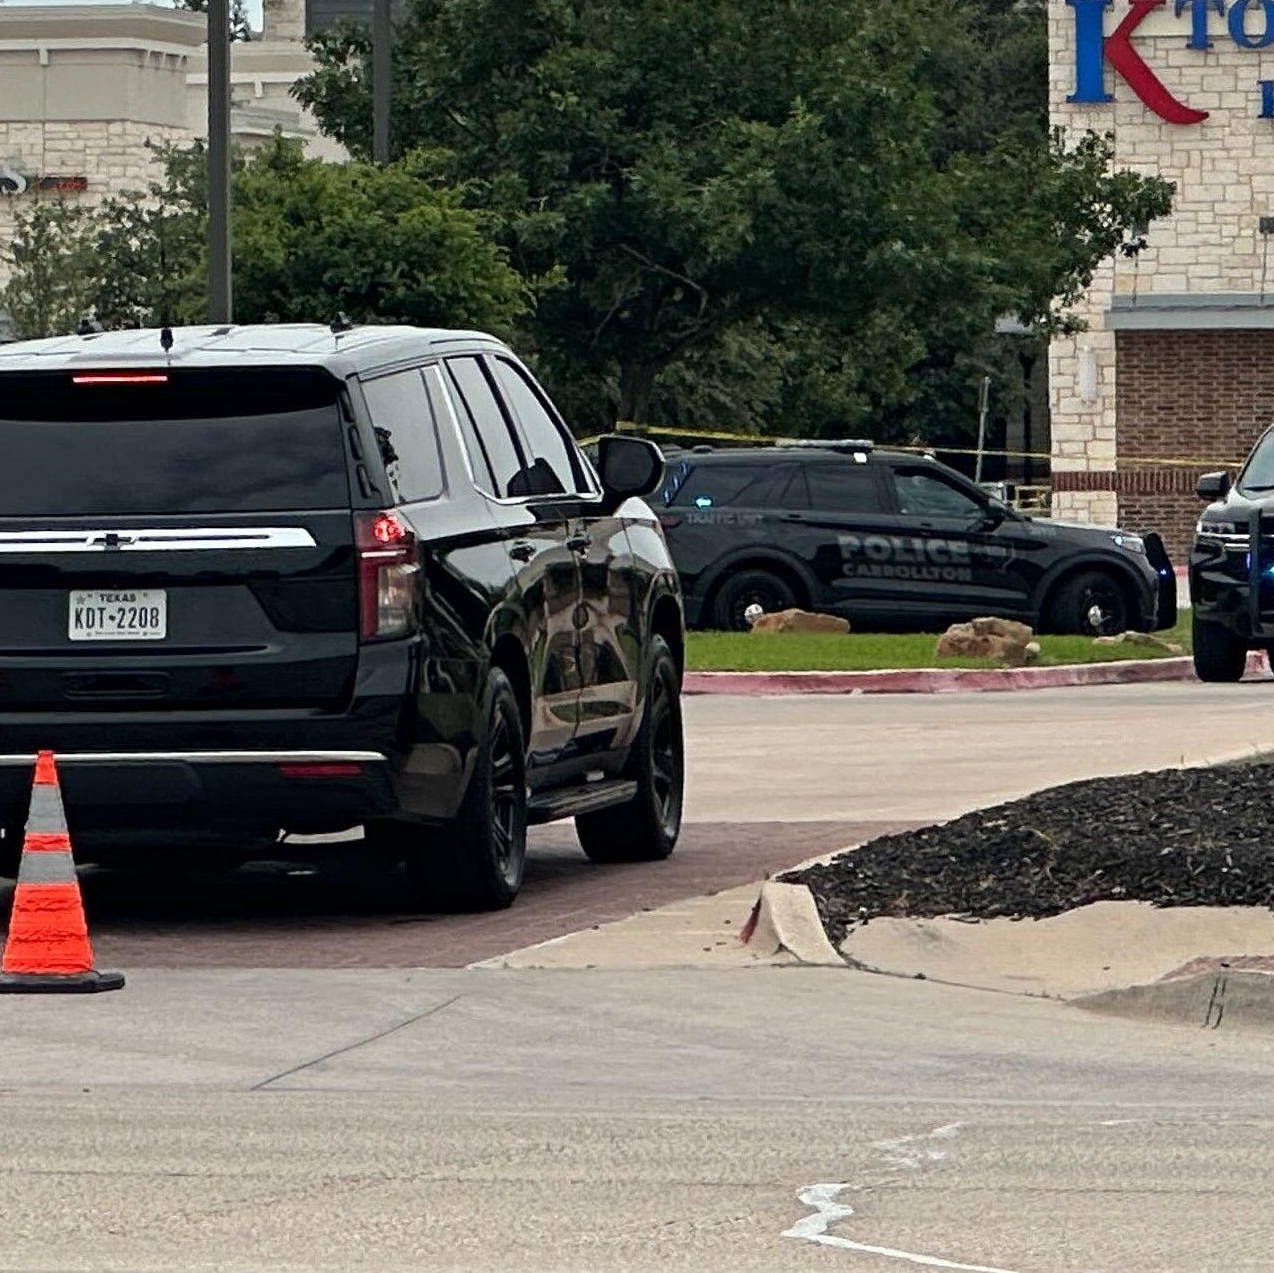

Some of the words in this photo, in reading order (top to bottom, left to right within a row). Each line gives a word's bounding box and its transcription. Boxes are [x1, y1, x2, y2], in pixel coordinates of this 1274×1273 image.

[838, 535, 971, 564] POLICE
[842, 563, 972, 582] CARROLLTON
[99, 592, 136, 603] TEXAS
